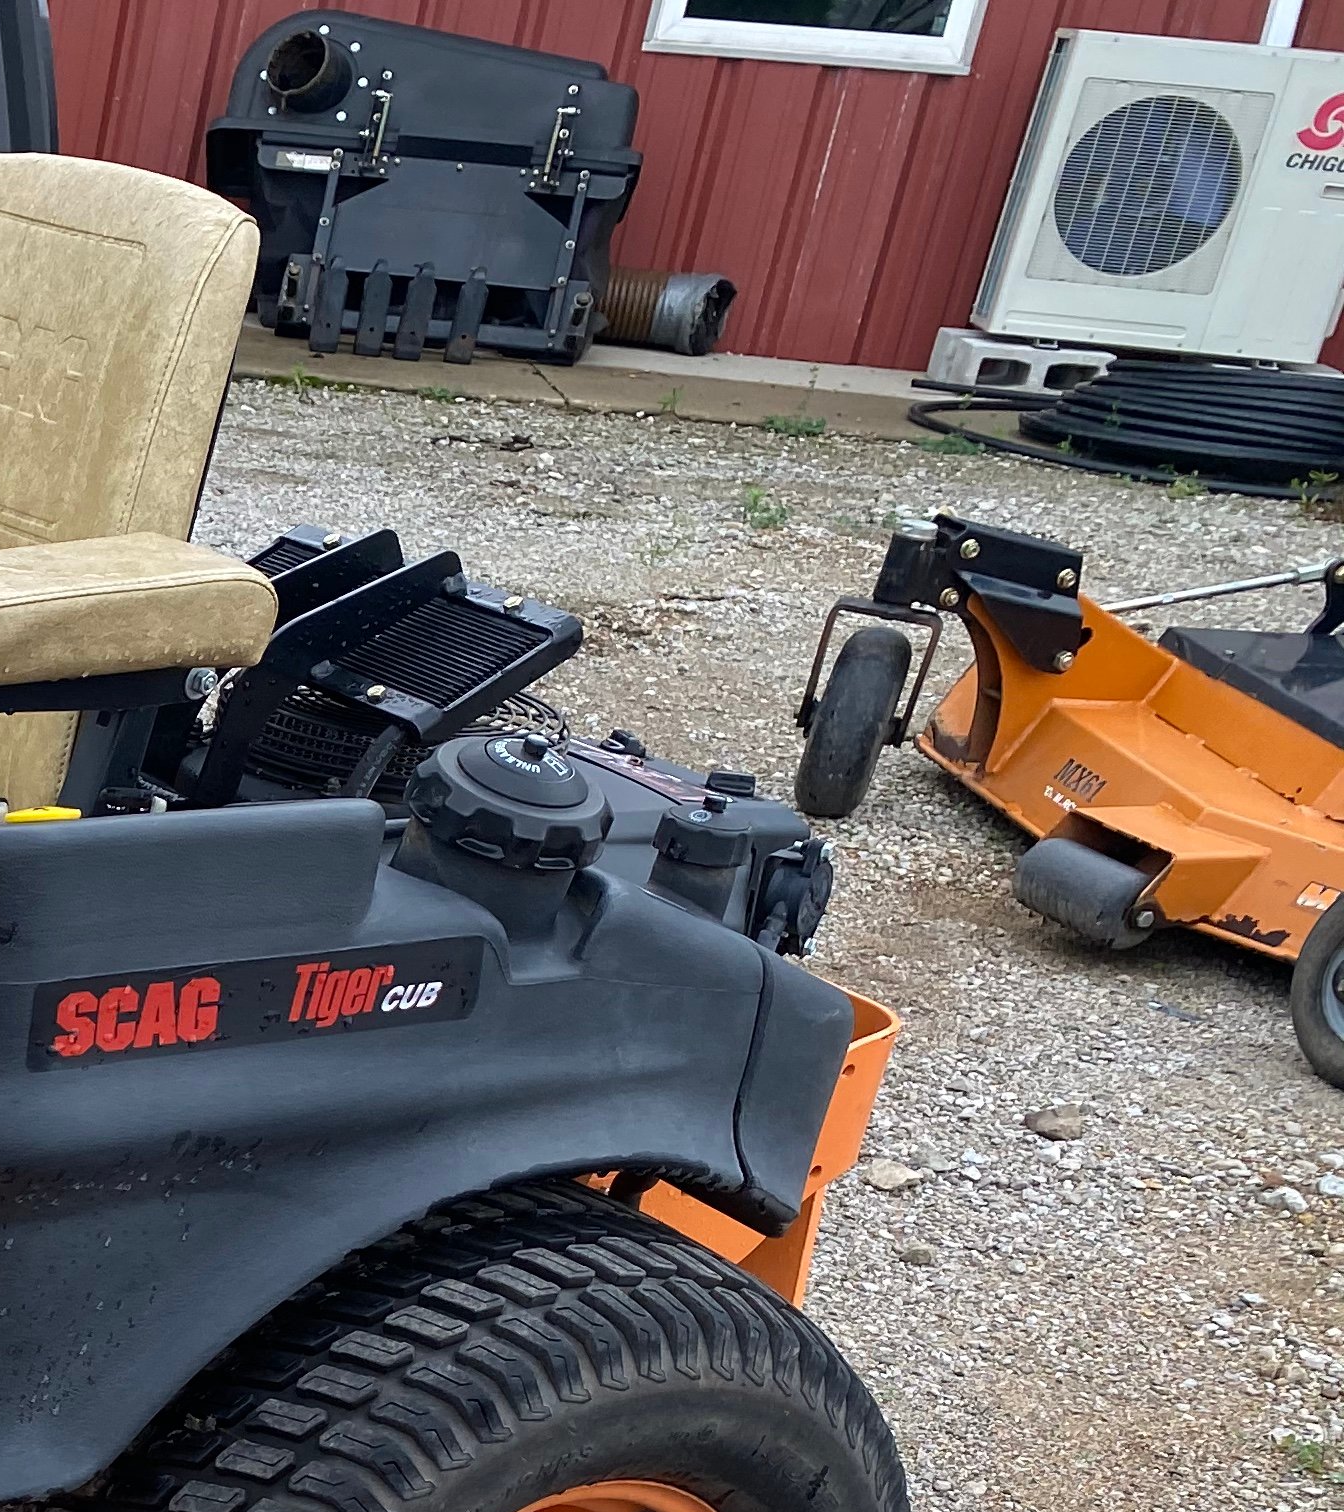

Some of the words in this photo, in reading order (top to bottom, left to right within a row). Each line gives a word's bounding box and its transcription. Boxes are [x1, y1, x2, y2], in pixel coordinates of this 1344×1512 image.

[1054, 758, 1107, 803] MX61
[53, 977, 221, 1057] SCAG
[289, 961, 395, 1028] Tiger
[380, 981, 443, 1013] CUB
